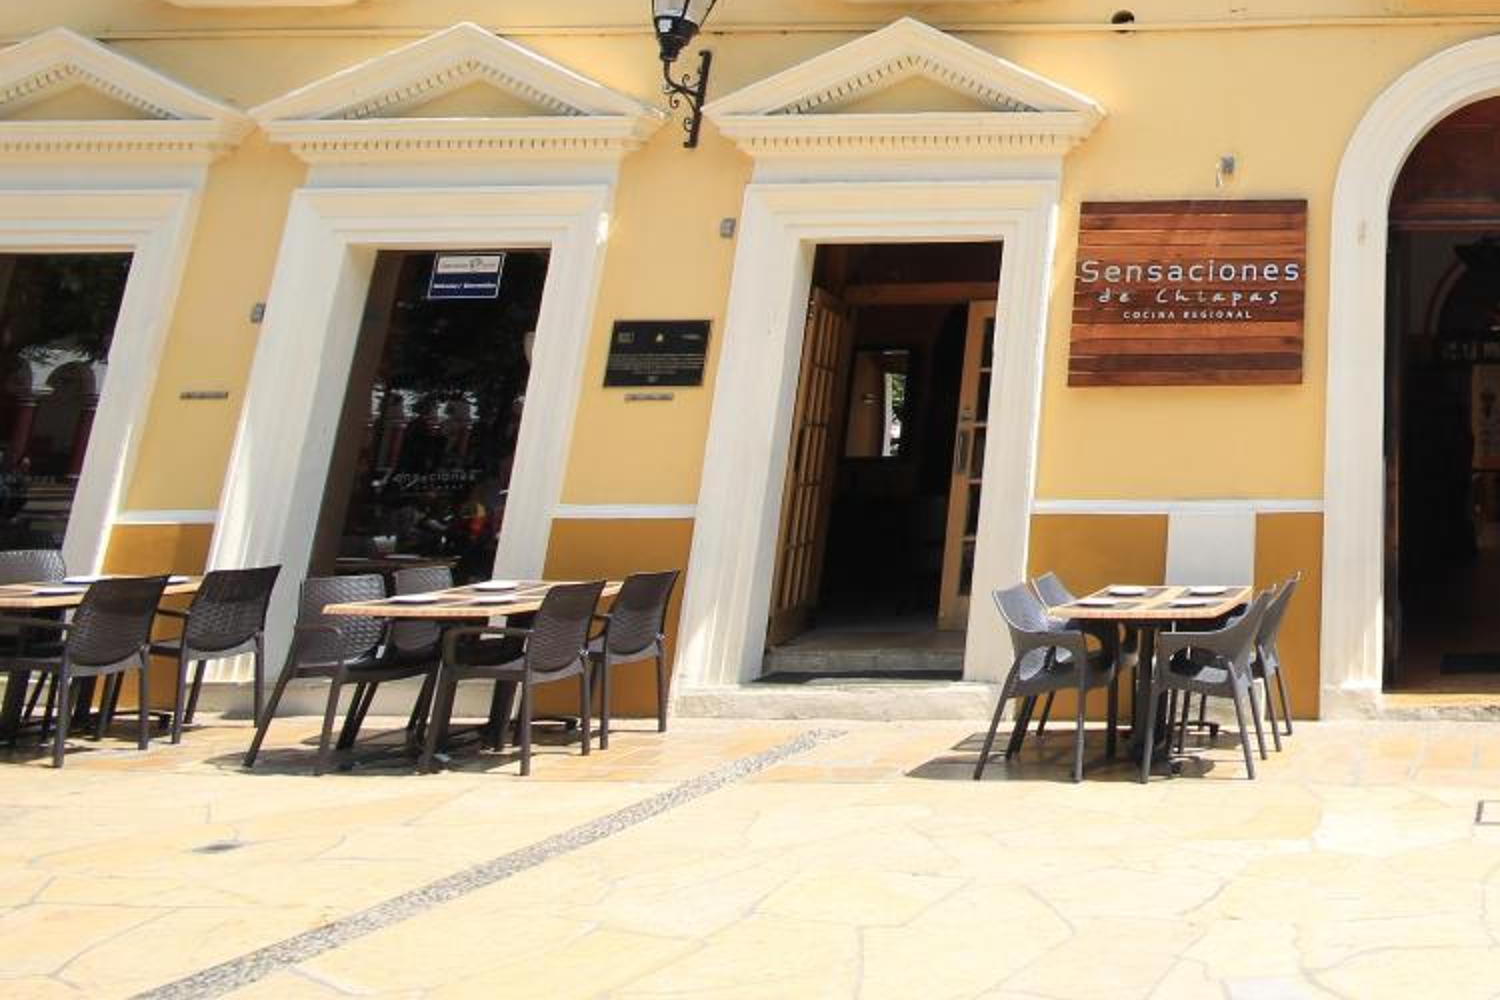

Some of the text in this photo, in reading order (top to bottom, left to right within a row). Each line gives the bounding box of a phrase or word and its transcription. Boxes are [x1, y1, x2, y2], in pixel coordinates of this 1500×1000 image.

[1080, 259, 1299, 283] Sensaciones
[1098, 288, 1280, 306] de Chiapas
[1123, 310, 1253, 320] COCINA REGIONAL
